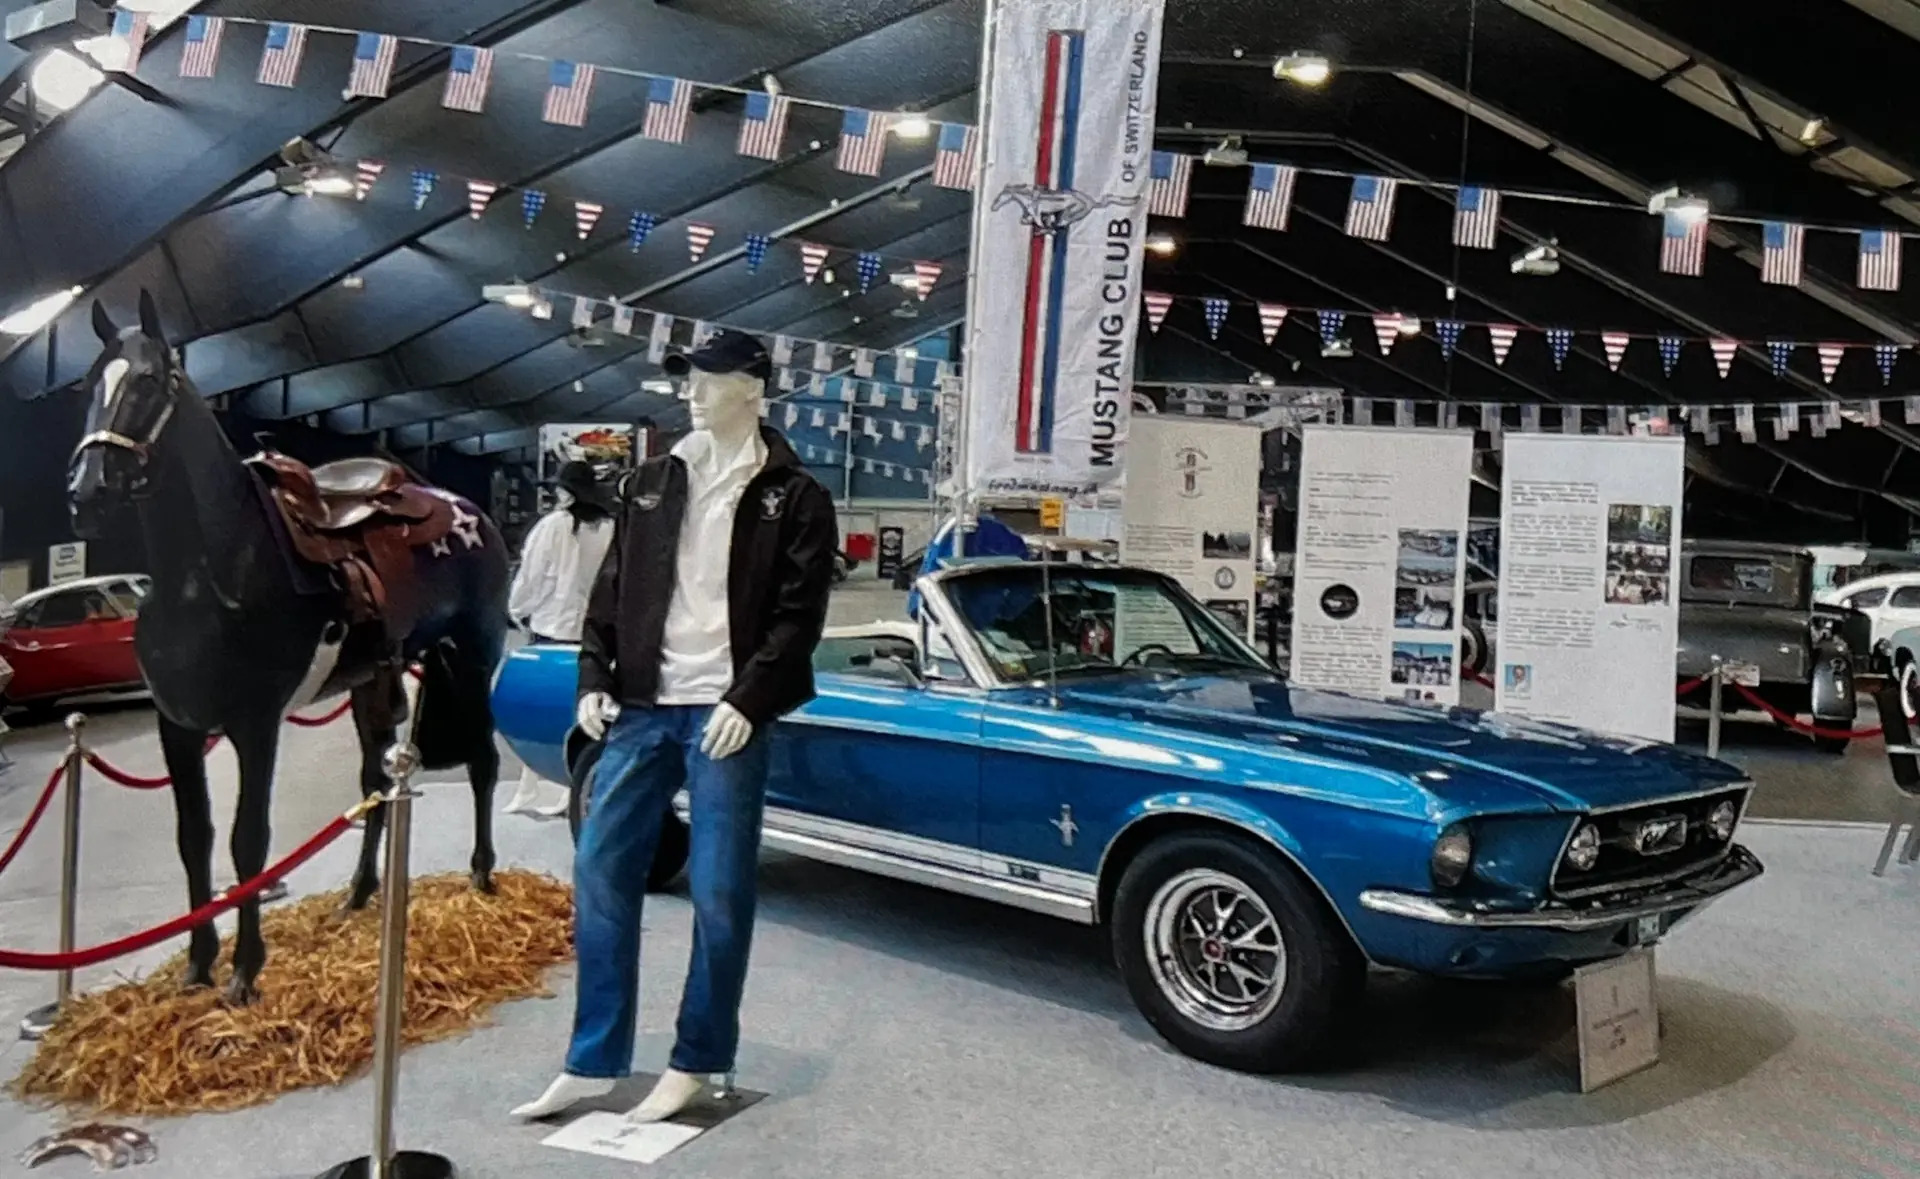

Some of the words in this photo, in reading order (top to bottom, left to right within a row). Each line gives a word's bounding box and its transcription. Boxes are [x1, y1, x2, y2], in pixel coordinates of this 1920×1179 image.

[1125, 31, 1148, 153] SWITZERLAND
[1122, 157, 1135, 183] OF
[1102, 216, 1132, 304] CLUB
[1090, 314, 1124, 467] MUSTANG
